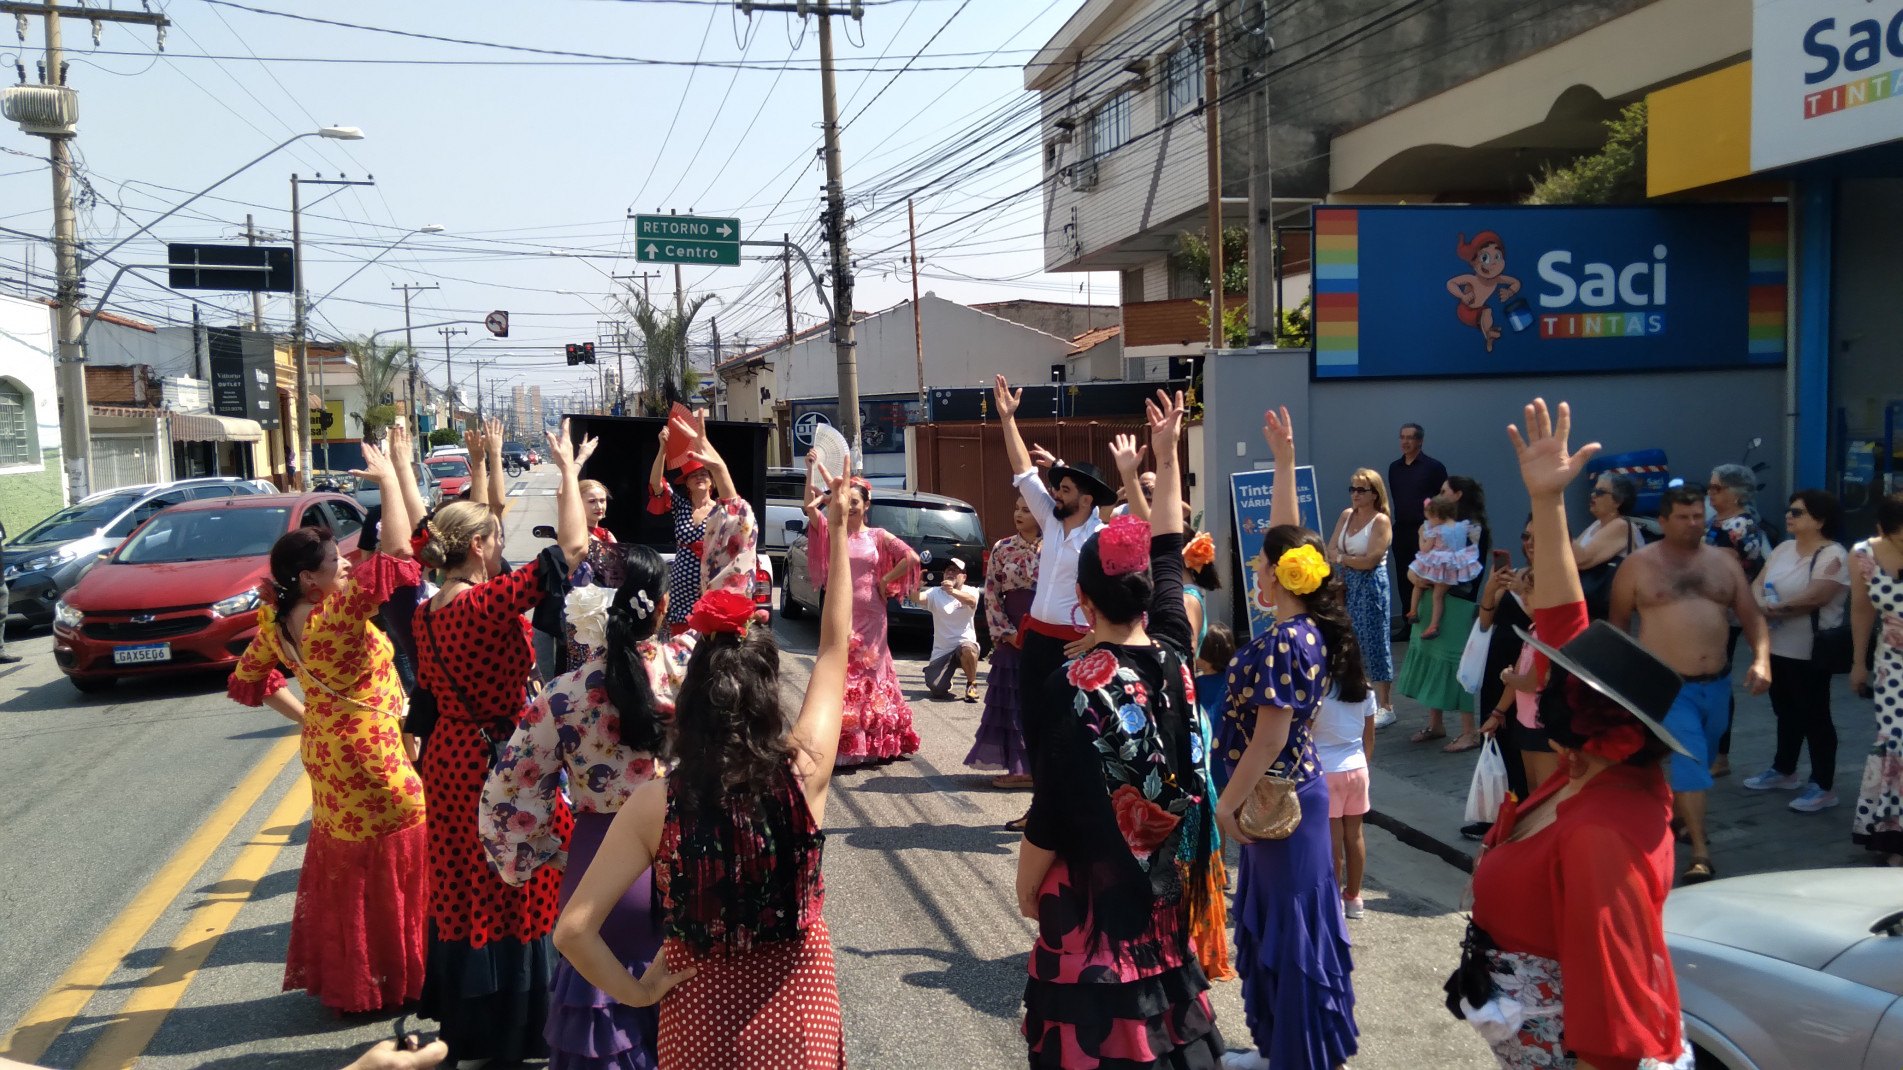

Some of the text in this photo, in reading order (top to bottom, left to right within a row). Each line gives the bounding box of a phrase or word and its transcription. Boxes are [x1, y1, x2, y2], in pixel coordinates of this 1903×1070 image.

[1803, 8, 1903, 85] Sac
[643, 221, 709, 235] RETORNO
[665, 245, 718, 259] Centro
[1537, 244, 1668, 308] Saci
[1543, 315, 1662, 335] TINTAS
[1240, 498, 1272, 509] VÁRIA
[119, 649, 165, 661] GAX5E06
